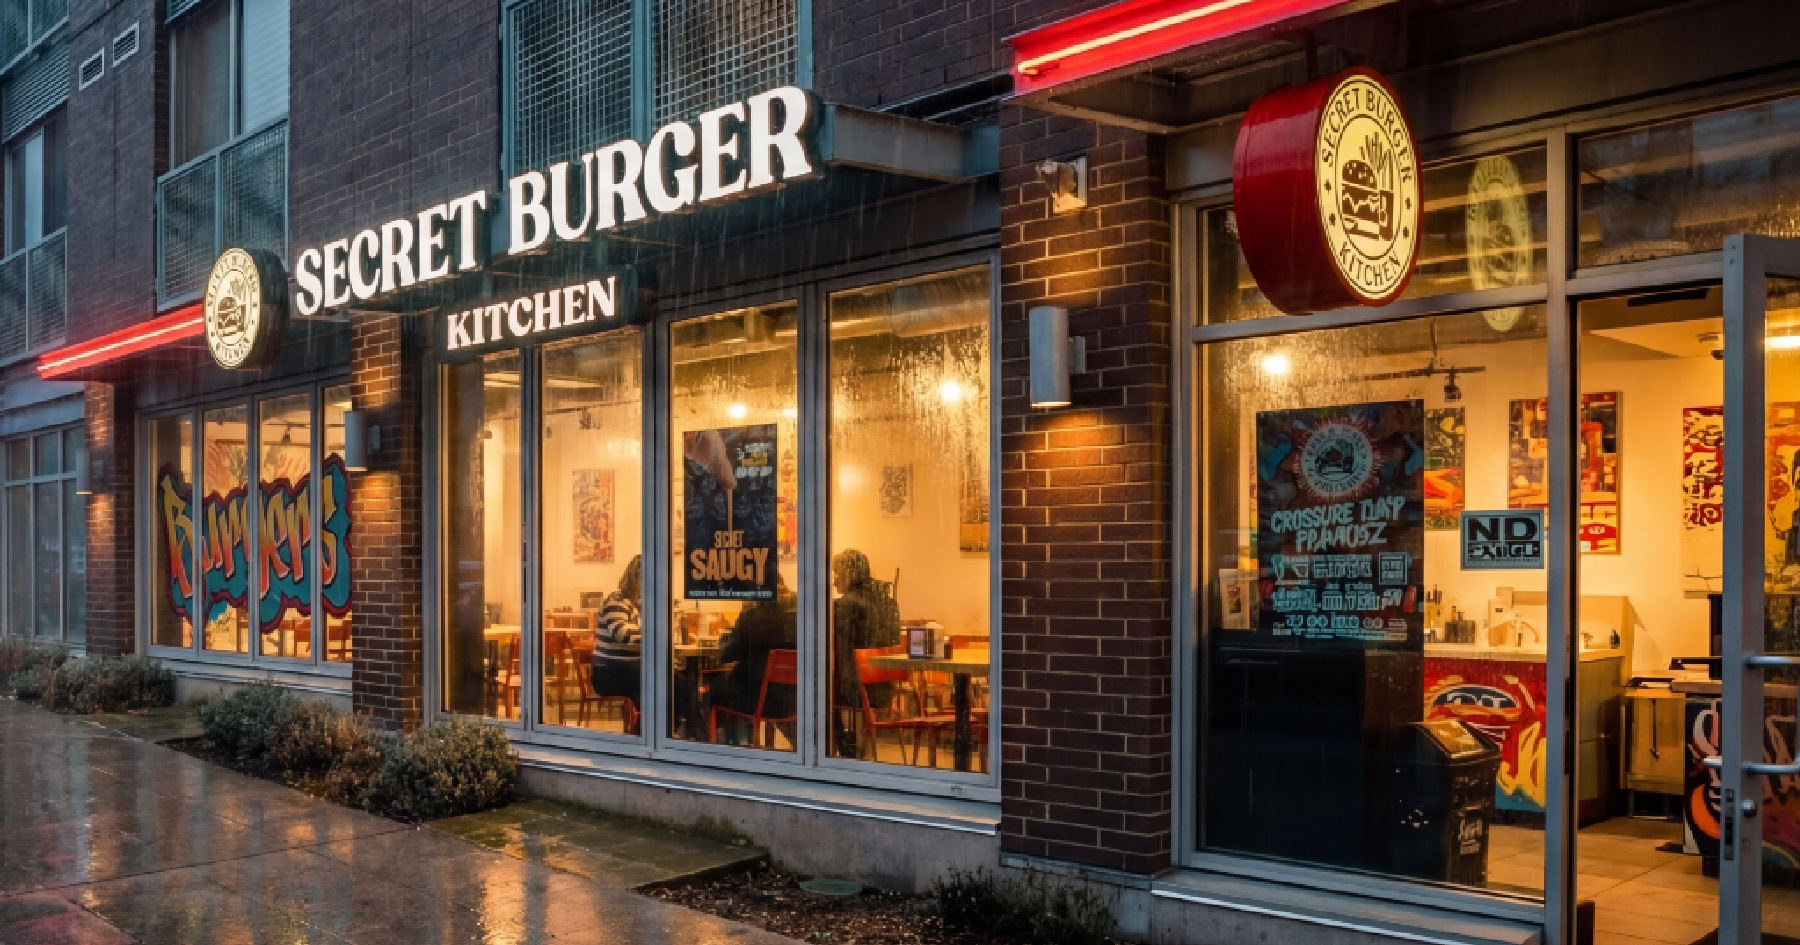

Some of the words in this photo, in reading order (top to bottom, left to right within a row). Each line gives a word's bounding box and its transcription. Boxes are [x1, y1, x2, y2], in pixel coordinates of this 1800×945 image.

[1321, 88, 1360, 167] SECRET
[1365, 89, 1413, 184] BURGER
[296, 190, 486, 316] SECRET
[508, 85, 813, 256] BURGER
[1339, 242, 1402, 287] KITCHEN
[447, 275, 617, 351] KITCHEN
[690, 547, 769, 586] SAUGY
